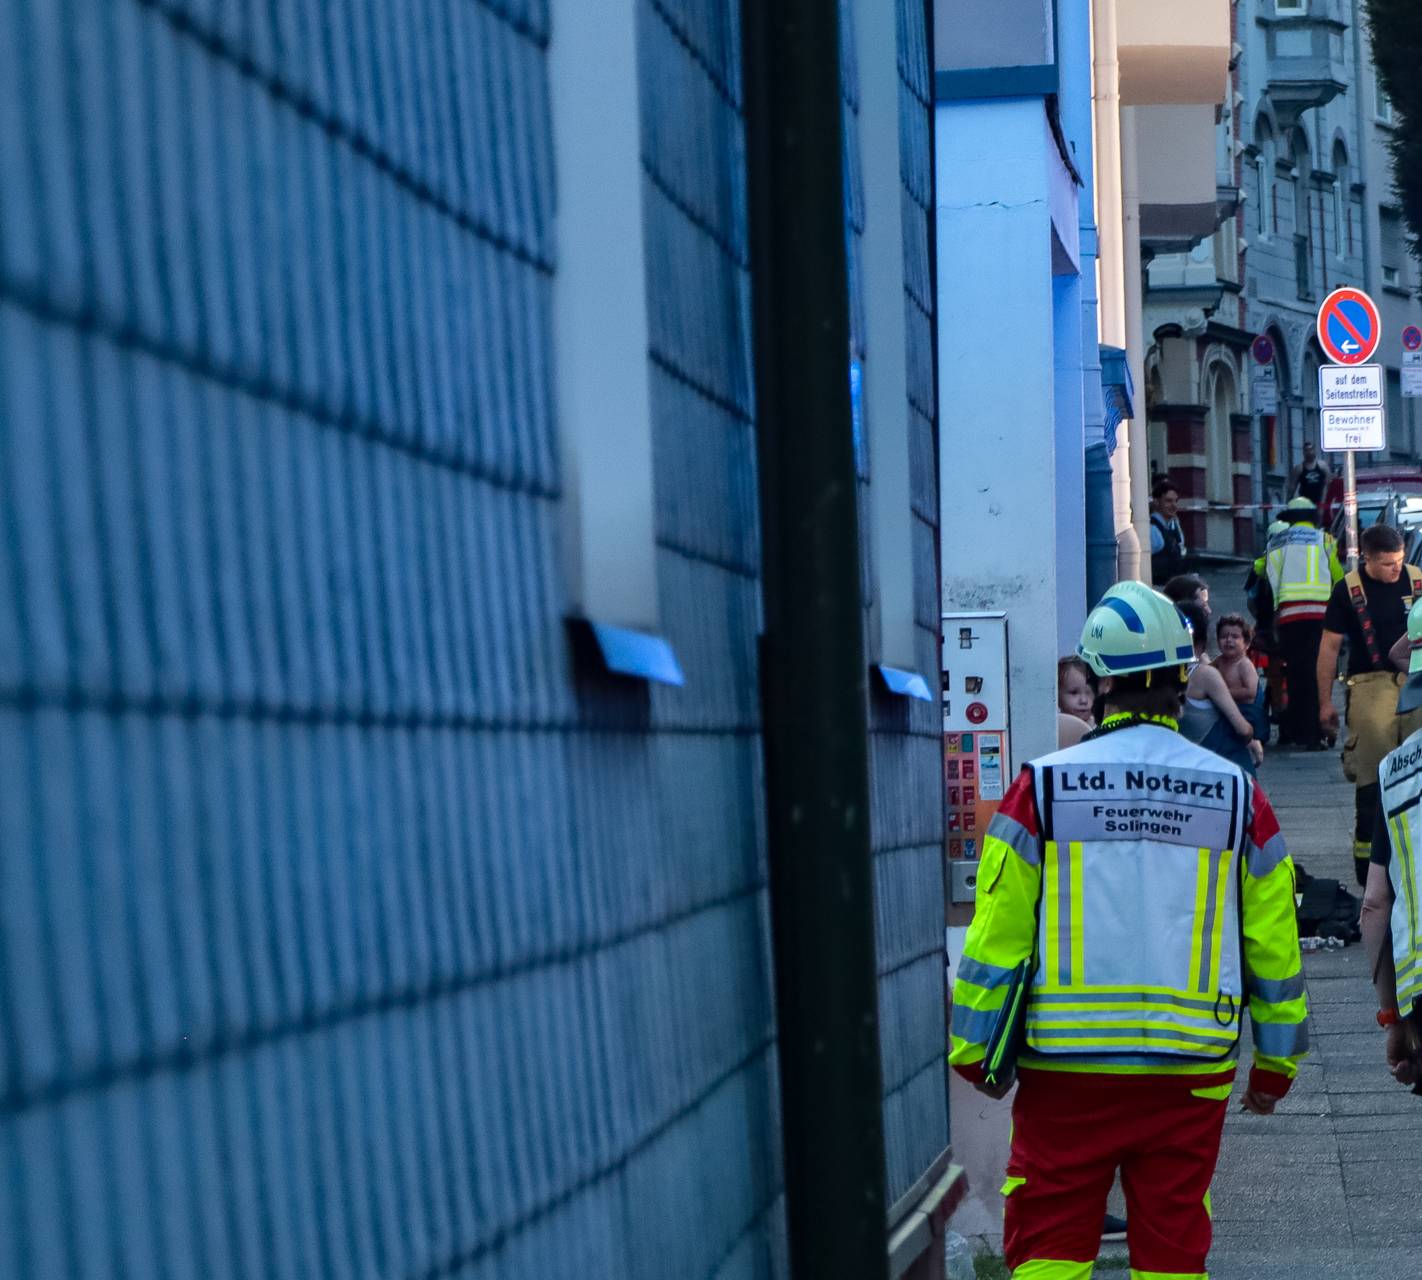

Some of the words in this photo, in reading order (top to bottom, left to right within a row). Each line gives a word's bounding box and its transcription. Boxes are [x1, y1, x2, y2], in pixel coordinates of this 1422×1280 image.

[1335, 374, 1347, 385] auf
[1351, 373, 1368, 385] dem
[1325, 388, 1378, 400] Seitenstreifen
[1328, 414, 1376, 425] Bewohner
[1345, 433, 1362, 444] frei
[1061, 771, 1115, 791] Ltd.
[1126, 770, 1225, 800] Notarzt
[1093, 806, 1193, 823] Feuerwehr
[1105, 820, 1182, 836] Solingen
